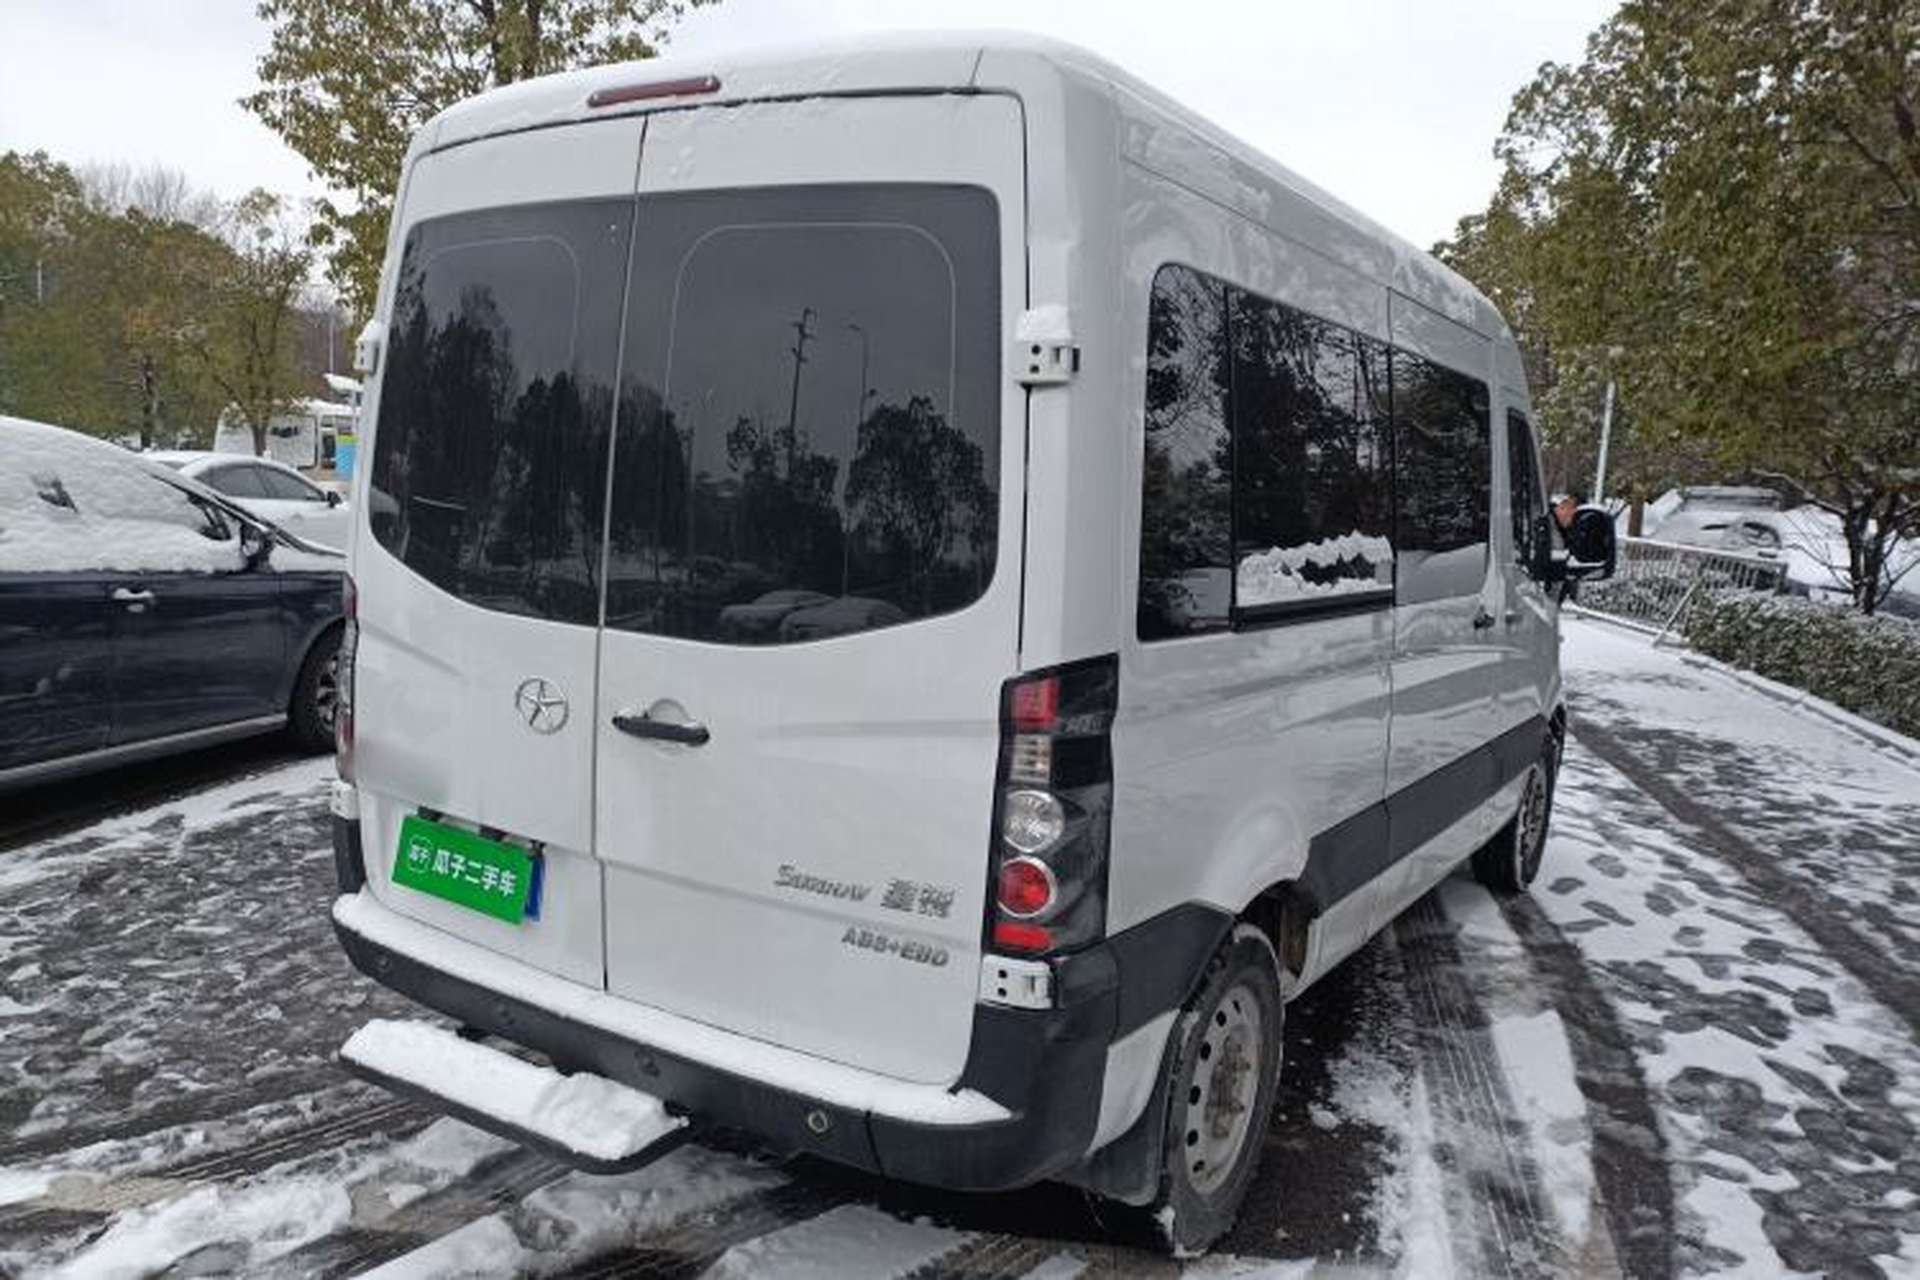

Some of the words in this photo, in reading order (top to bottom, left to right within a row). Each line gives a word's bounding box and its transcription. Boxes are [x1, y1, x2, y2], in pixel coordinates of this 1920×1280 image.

[432, 849, 517, 897] 瓜子二手车
